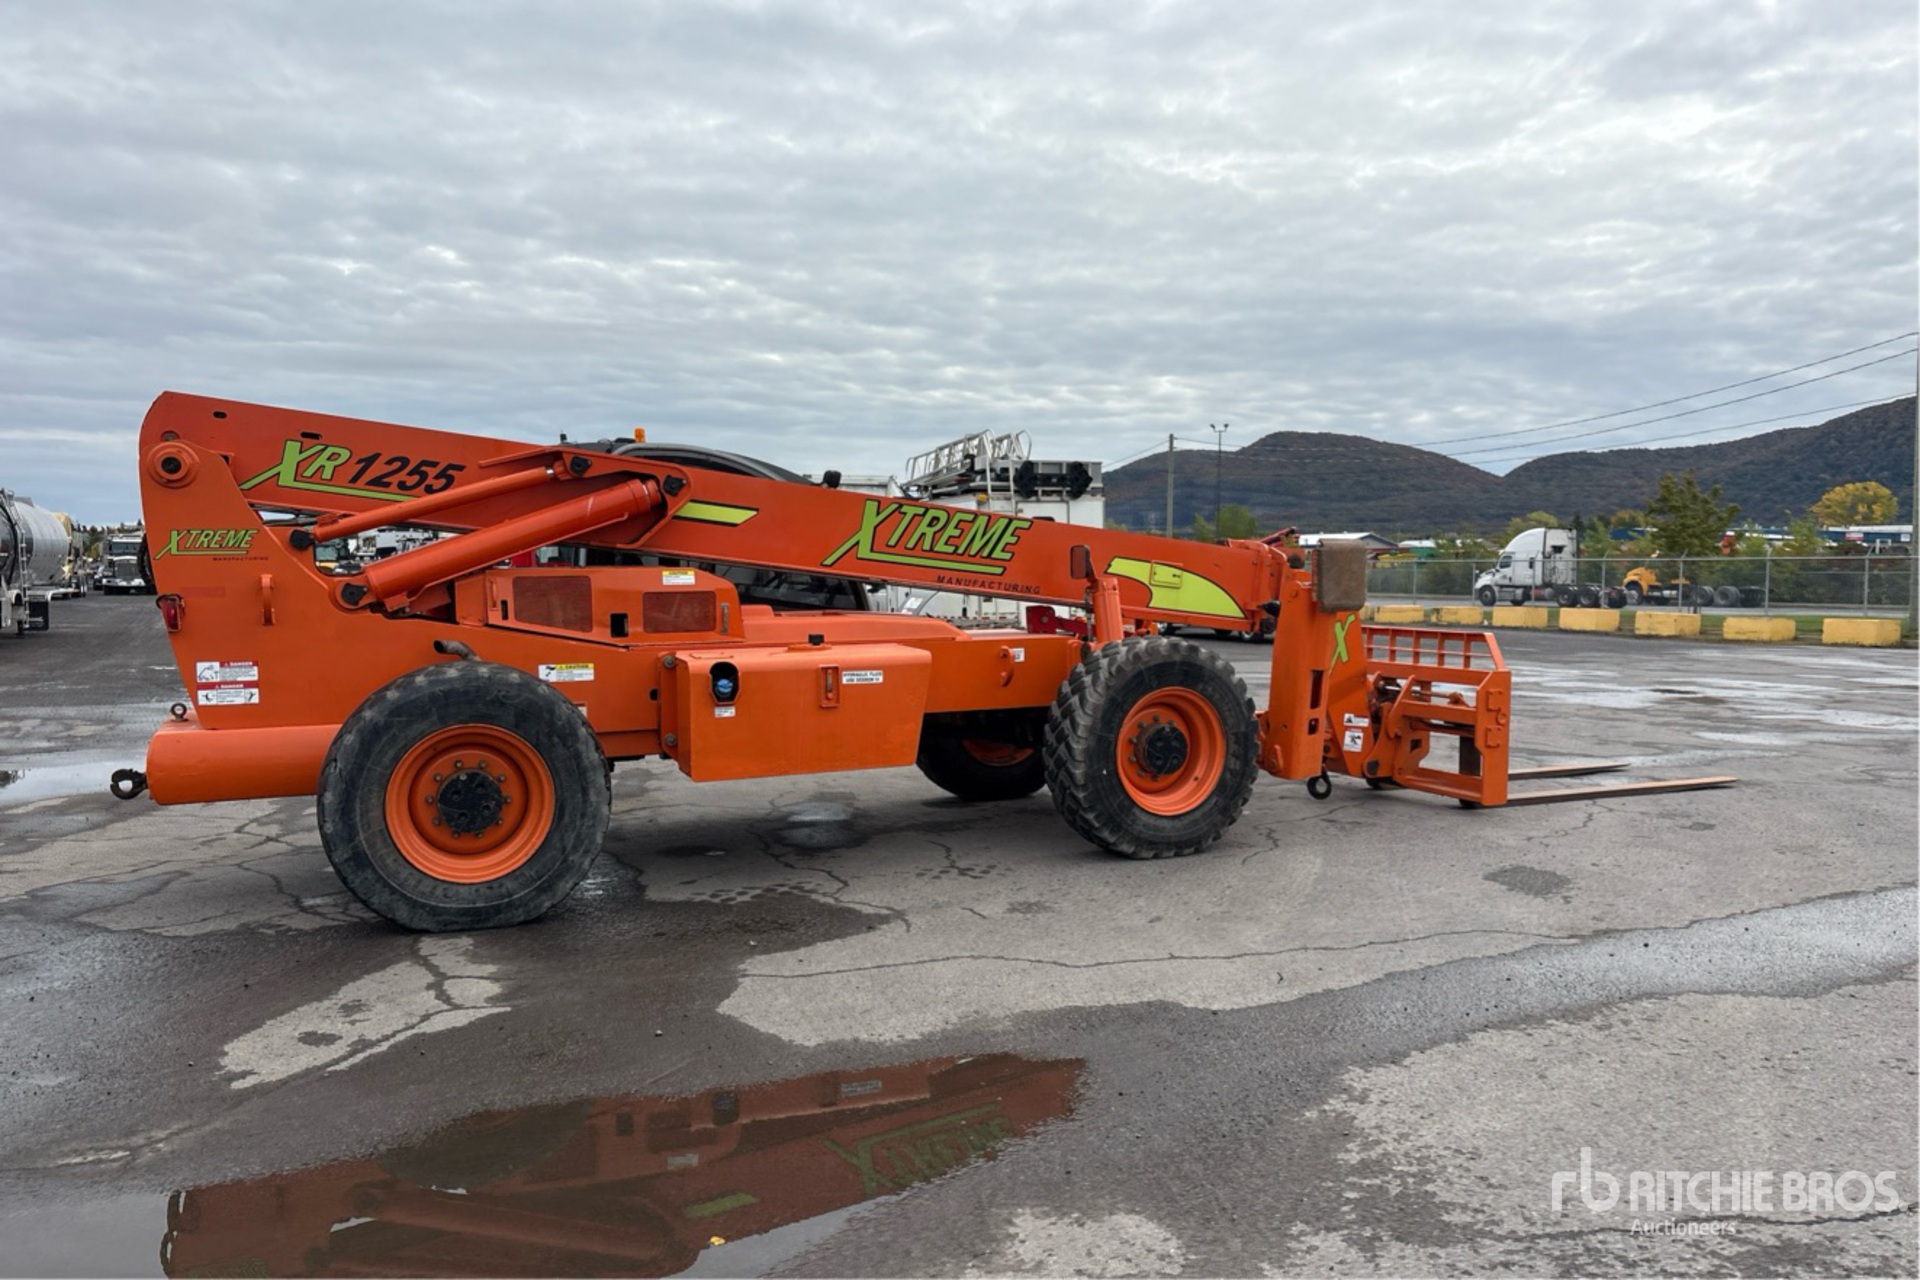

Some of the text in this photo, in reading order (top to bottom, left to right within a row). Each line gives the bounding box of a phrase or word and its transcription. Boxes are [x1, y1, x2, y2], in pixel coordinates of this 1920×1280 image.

[349, 452, 466, 495] 1255
[155, 529, 258, 560] XTREME
[820, 499, 1033, 566] XTREME
[937, 574, 1041, 595] MANUFACTURING
